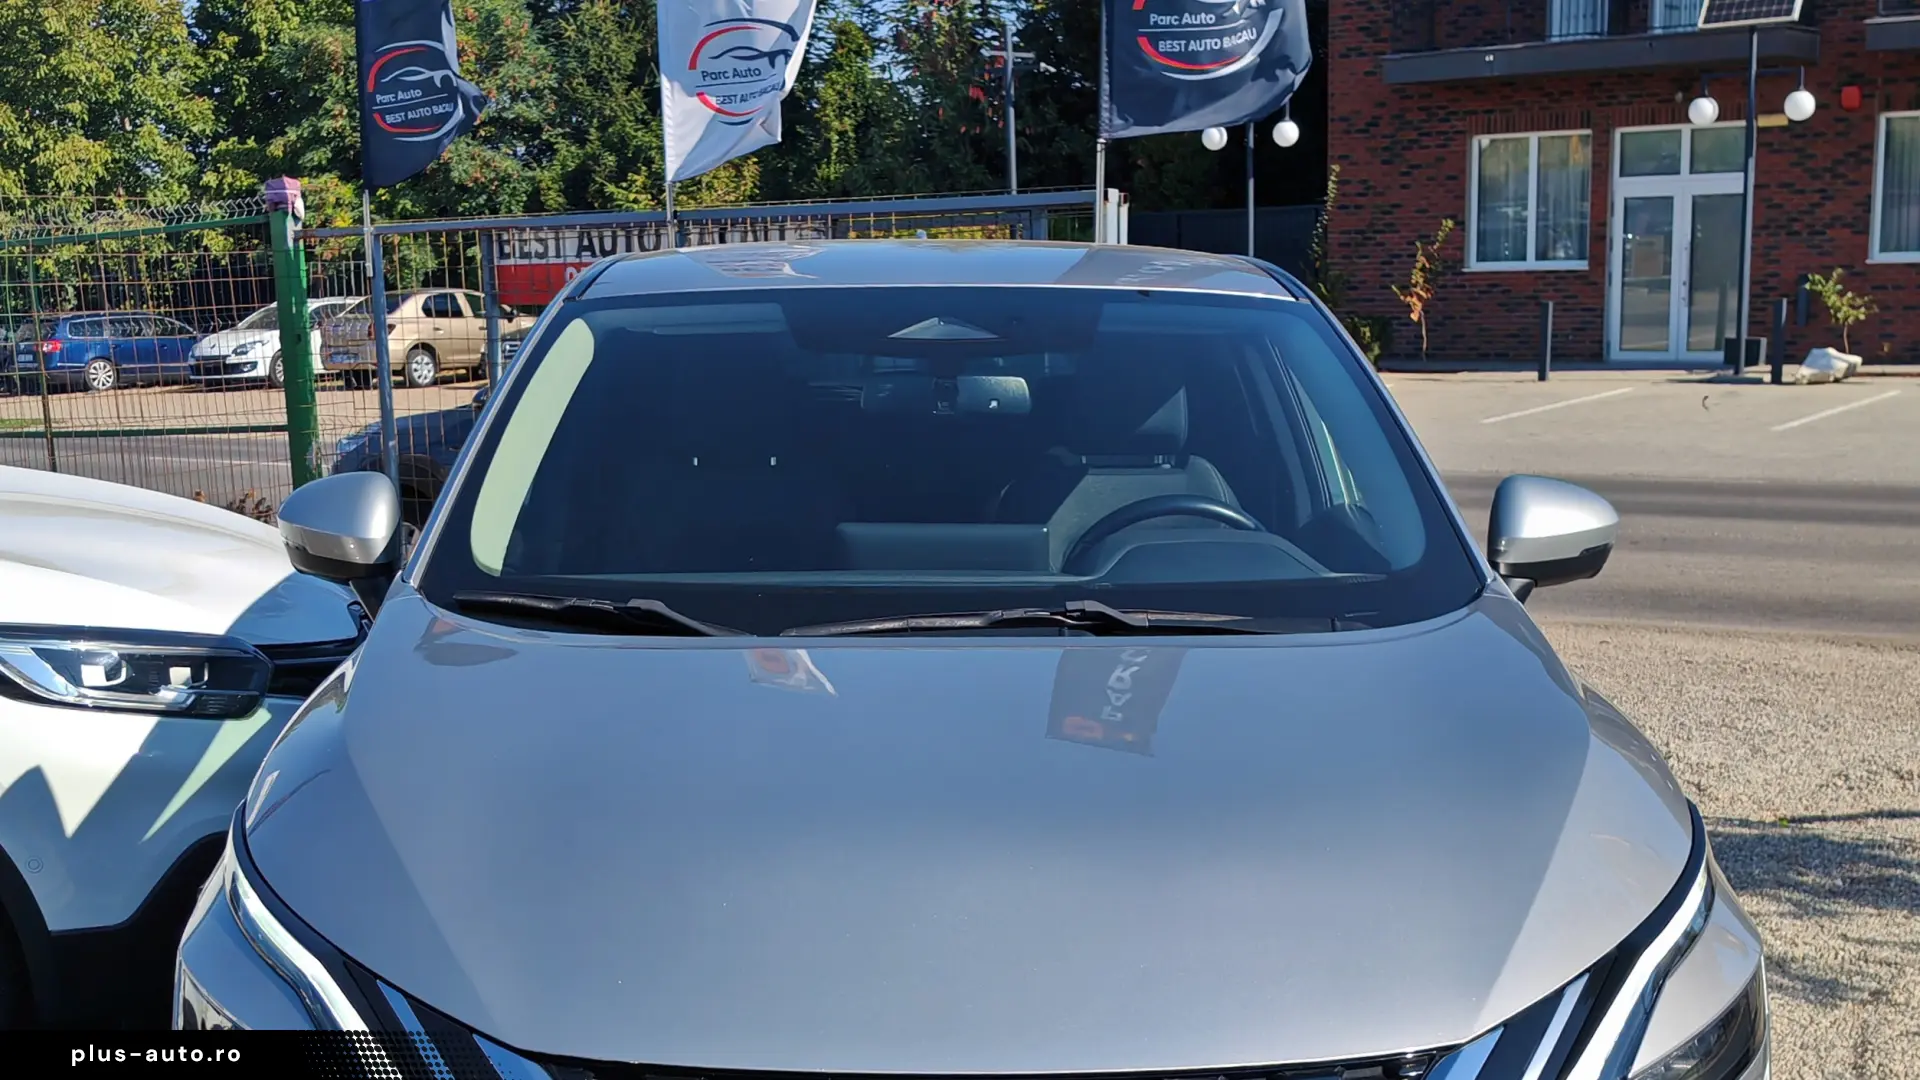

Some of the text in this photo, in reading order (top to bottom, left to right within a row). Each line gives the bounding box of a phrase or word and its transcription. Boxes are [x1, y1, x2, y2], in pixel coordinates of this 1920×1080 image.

[1150, 12, 1216, 25] Parc Auto
[1158, 27, 1257, 52] BEST AUTO BACAU
[701, 67, 761, 81] Parc Auto
[376, 89, 422, 104] Parc Auto
[715, 94, 738, 105] BEST
[385, 112, 406, 124] BEST
[407, 107, 431, 119] AUTO
[497, 228, 563, 260] BEST
[576, 226, 663, 259] AUTO
